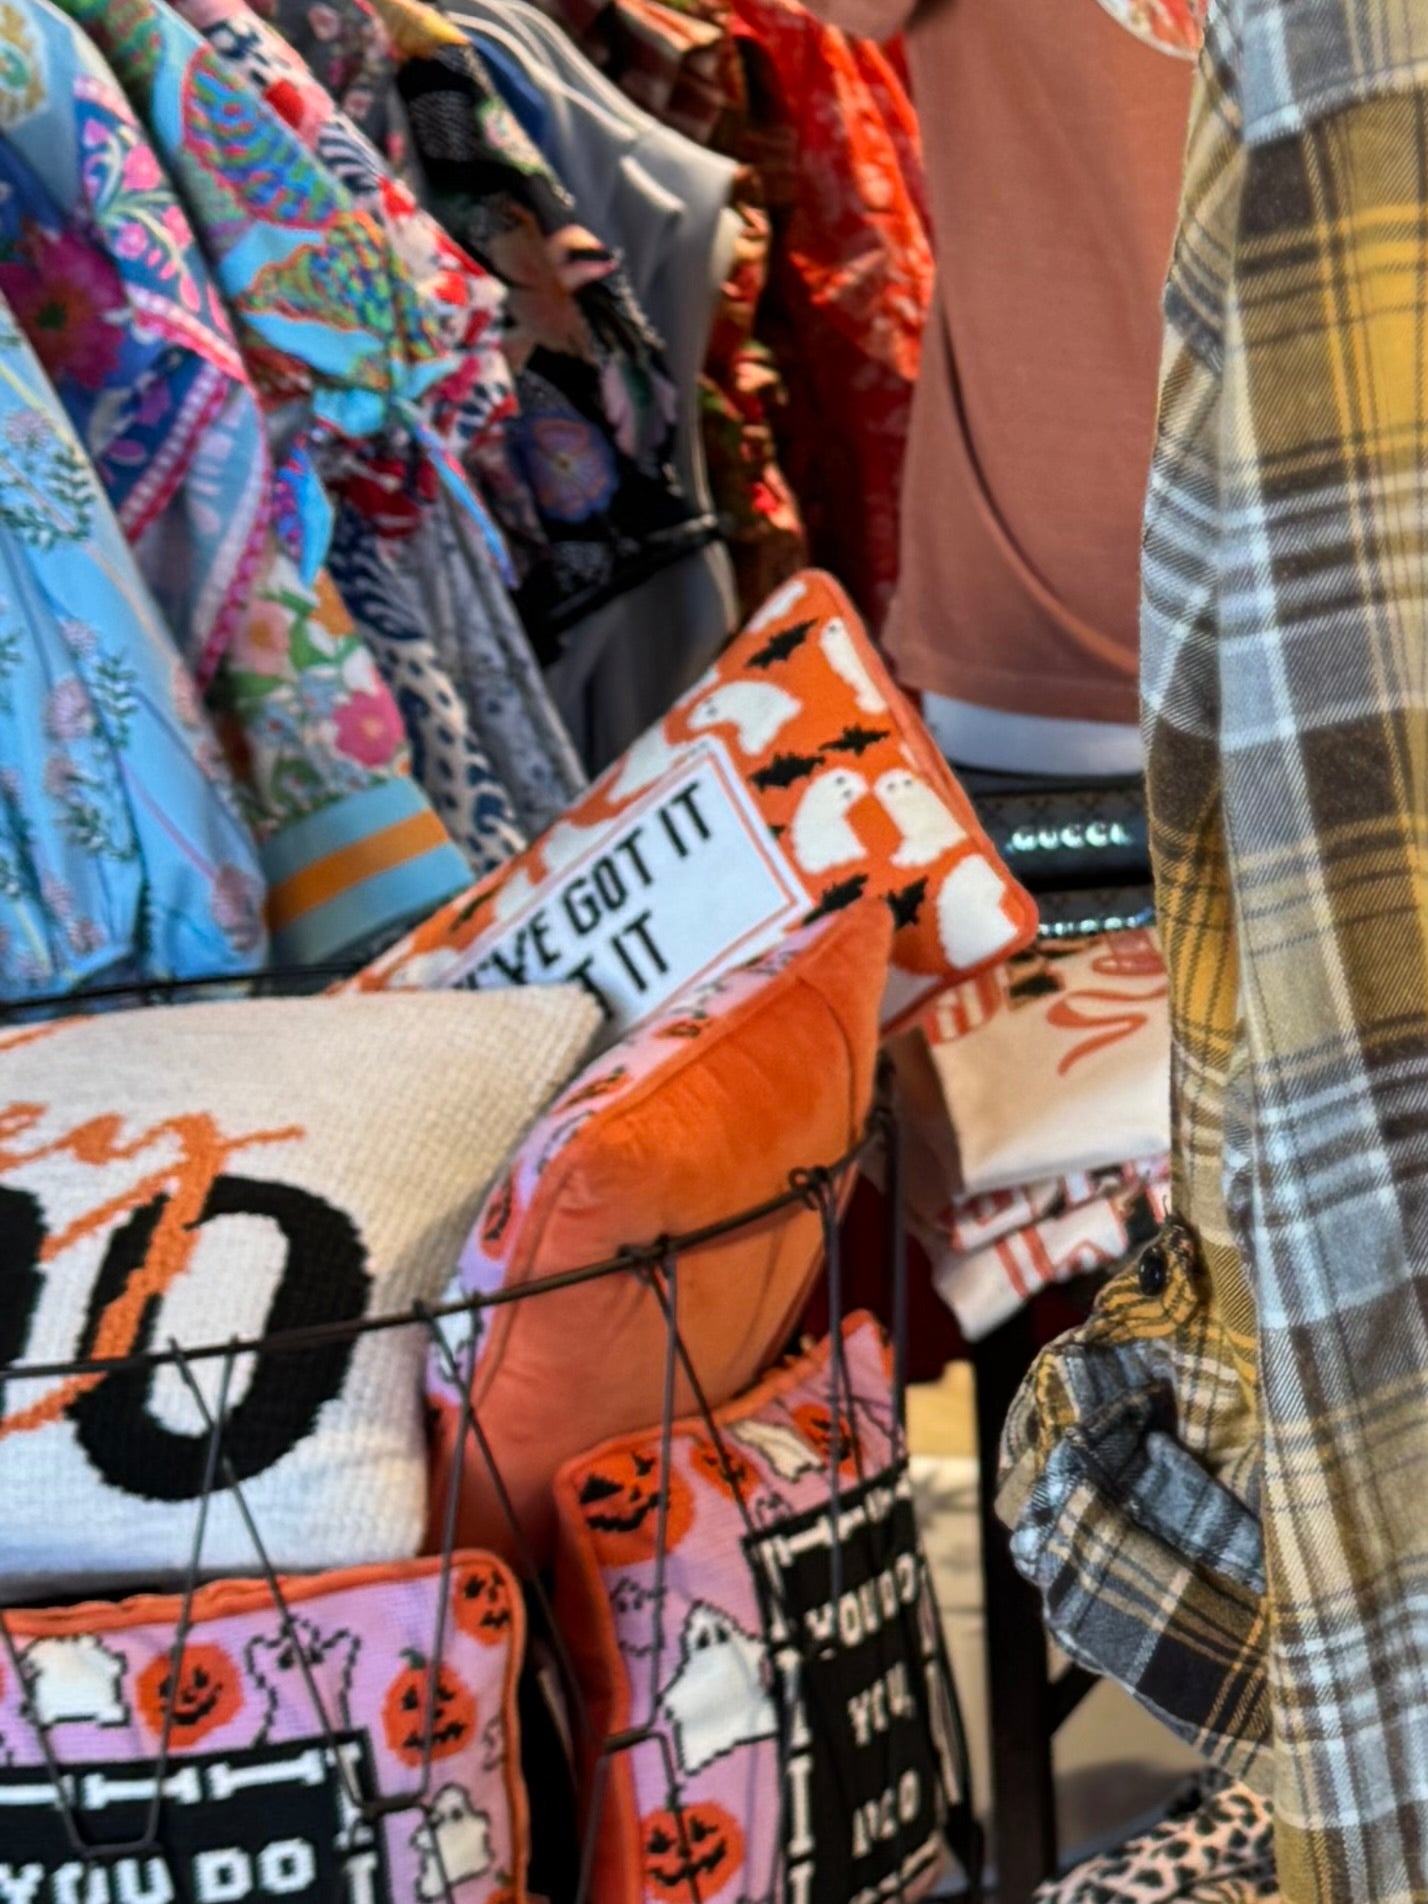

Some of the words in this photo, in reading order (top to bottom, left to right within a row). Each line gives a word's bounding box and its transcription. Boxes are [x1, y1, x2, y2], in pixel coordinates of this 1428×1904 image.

[561, 826, 653, 936] GOT
[659, 781, 713, 859] IT
[609, 909, 670, 994] IT
